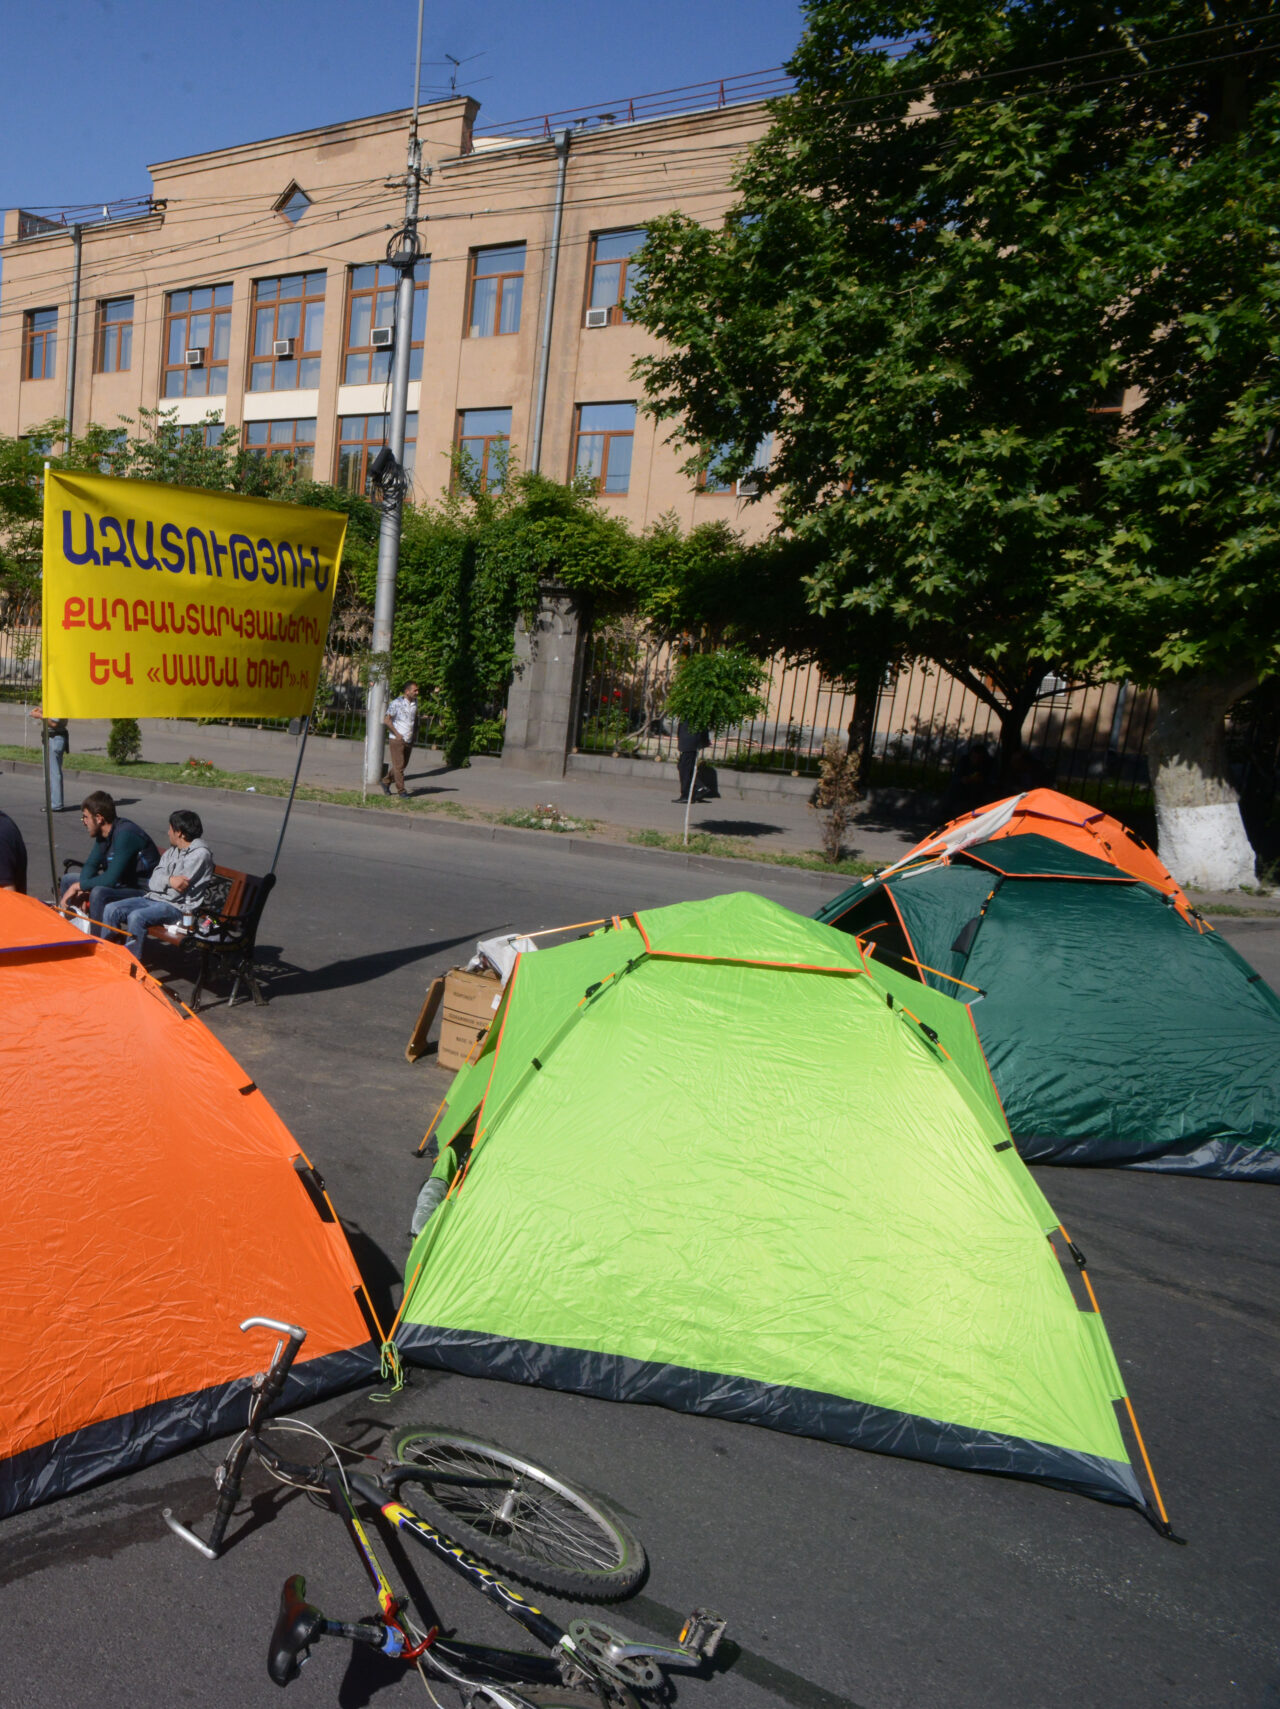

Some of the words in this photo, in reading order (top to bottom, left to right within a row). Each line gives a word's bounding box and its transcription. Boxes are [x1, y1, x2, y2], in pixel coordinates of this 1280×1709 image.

[62, 510, 330, 592] ԱԶԱՏՈՒԹՅՈՒՆ
[61, 596, 321, 646] ՔԱՂԲԱՆՏԱՐԿՅԱԼՆԵՐԻՆ
[89, 652, 134, 686] ԵՎ
[147, 653, 239, 688] «ՍԱՍՆԱ
